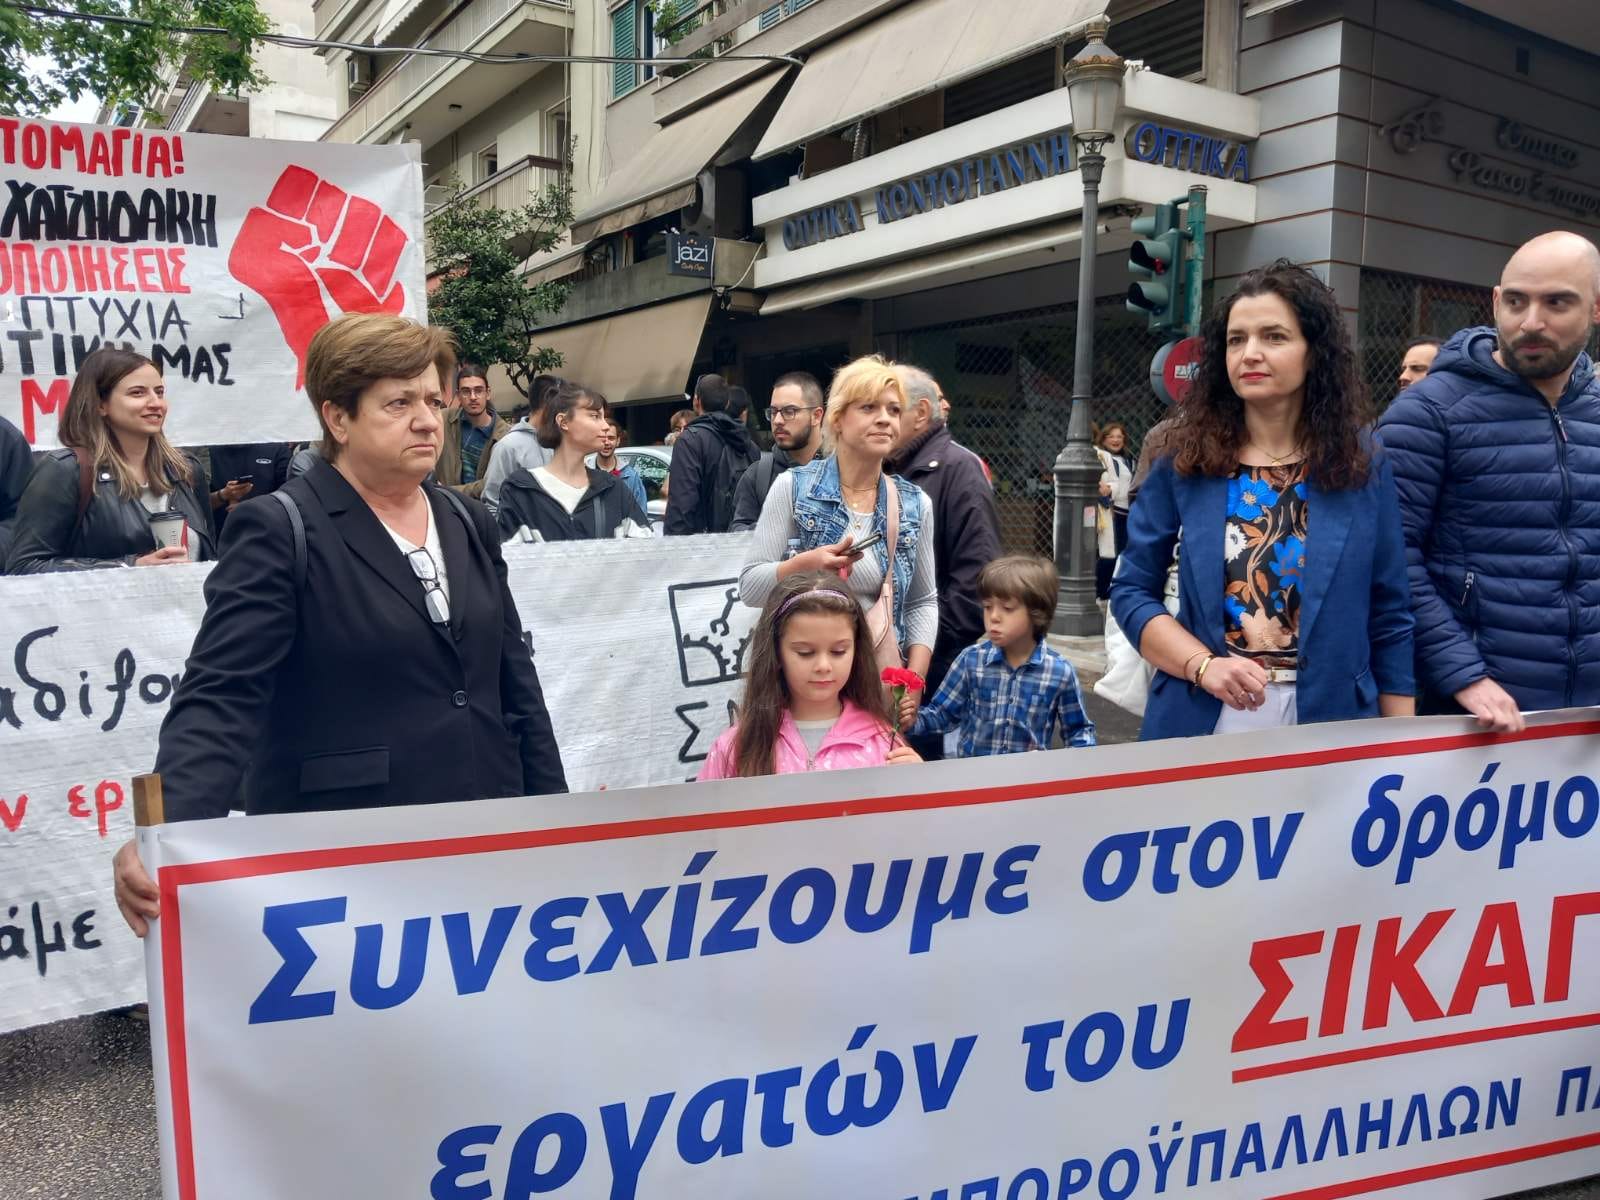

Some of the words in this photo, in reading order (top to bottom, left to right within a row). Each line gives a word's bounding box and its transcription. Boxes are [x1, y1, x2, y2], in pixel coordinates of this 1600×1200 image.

[783, 199, 865, 250] ΟΠΤΙΚΑ
[875, 132, 1073, 223] ΚΟΝΤΟΓΙΑΝΝΗ
[1135, 121, 1249, 182] ΟΠΤΙΚΑ
[675, 242, 708, 263] jazi
[0, 329, 136, 376] ΤΙΚ
[151, 342, 235, 386] ΜΑΣ
[20, 296, 191, 341] ΠΤΥΧΙΑ
[1082, 812, 1304, 902] στον
[1351, 762, 1600, 885] δρόμο
[430, 1024, 977, 1200] εργατών
[1021, 997, 1191, 1092] του
[903, 1077, 1521, 1200] ΟΡΟΫΠΑΛΛΗΛΩΝ
[1556, 1065, 1600, 1117] Π
